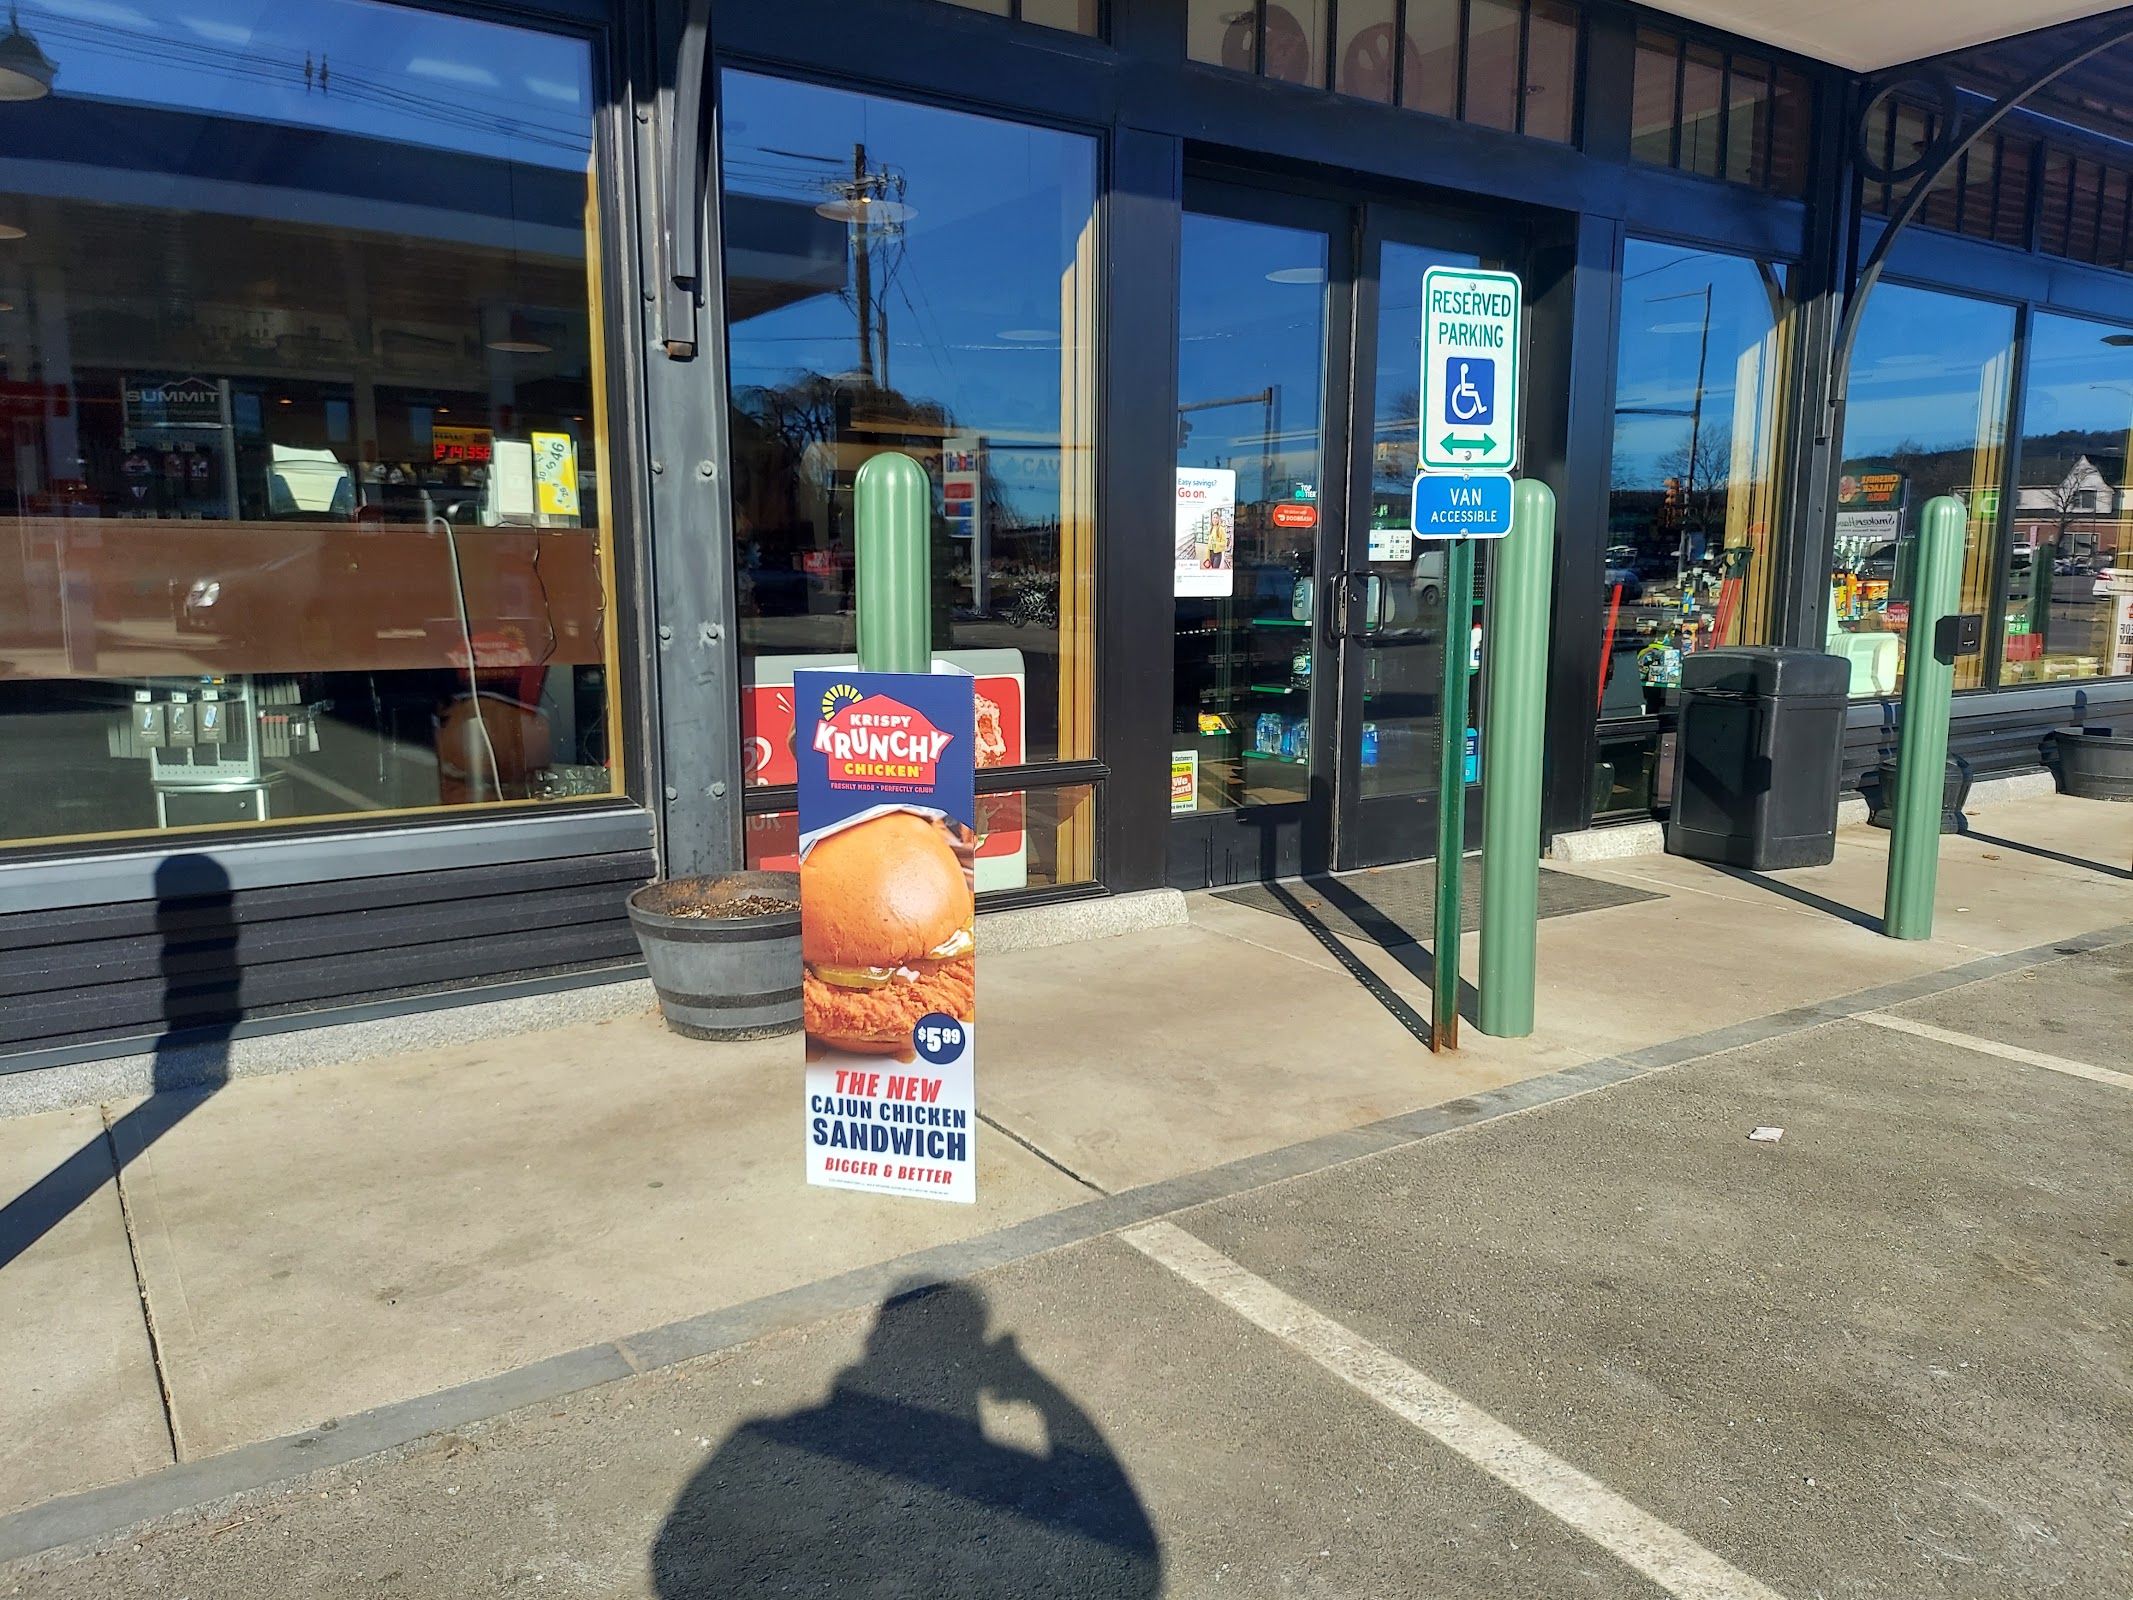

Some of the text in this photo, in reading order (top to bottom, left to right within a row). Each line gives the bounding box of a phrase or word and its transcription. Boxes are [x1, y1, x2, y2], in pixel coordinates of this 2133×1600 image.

[1432, 289, 1511, 317] RESERVED
[1439, 321, 1504, 349] PARKING
[126, 391, 220, 403] SUMMIT
[1178, 478, 1217, 489] Easy savings?
[1178, 487, 1207, 499] Go on.
[1449, 487, 1482, 506] VAN
[1430, 509, 1498, 523] ACCESSIBLE
[850, 714, 912, 728] KRISPY
[815, 722, 949, 763] KRUNCHY
[844, 763, 920, 778] CHICKEN
[830, 782, 857, 790] FRESHLY
[880, 785, 913, 793] PERFECTLY
[914, 786, 934, 794] CAJUN
[835, 1070, 943, 1104] THE NEW
[811, 1094, 966, 1129] CAJUN CHICKEN
[812, 1117, 966, 1162] SANDWICH
[825, 1157, 953, 1185] BIGGER & BETTER
